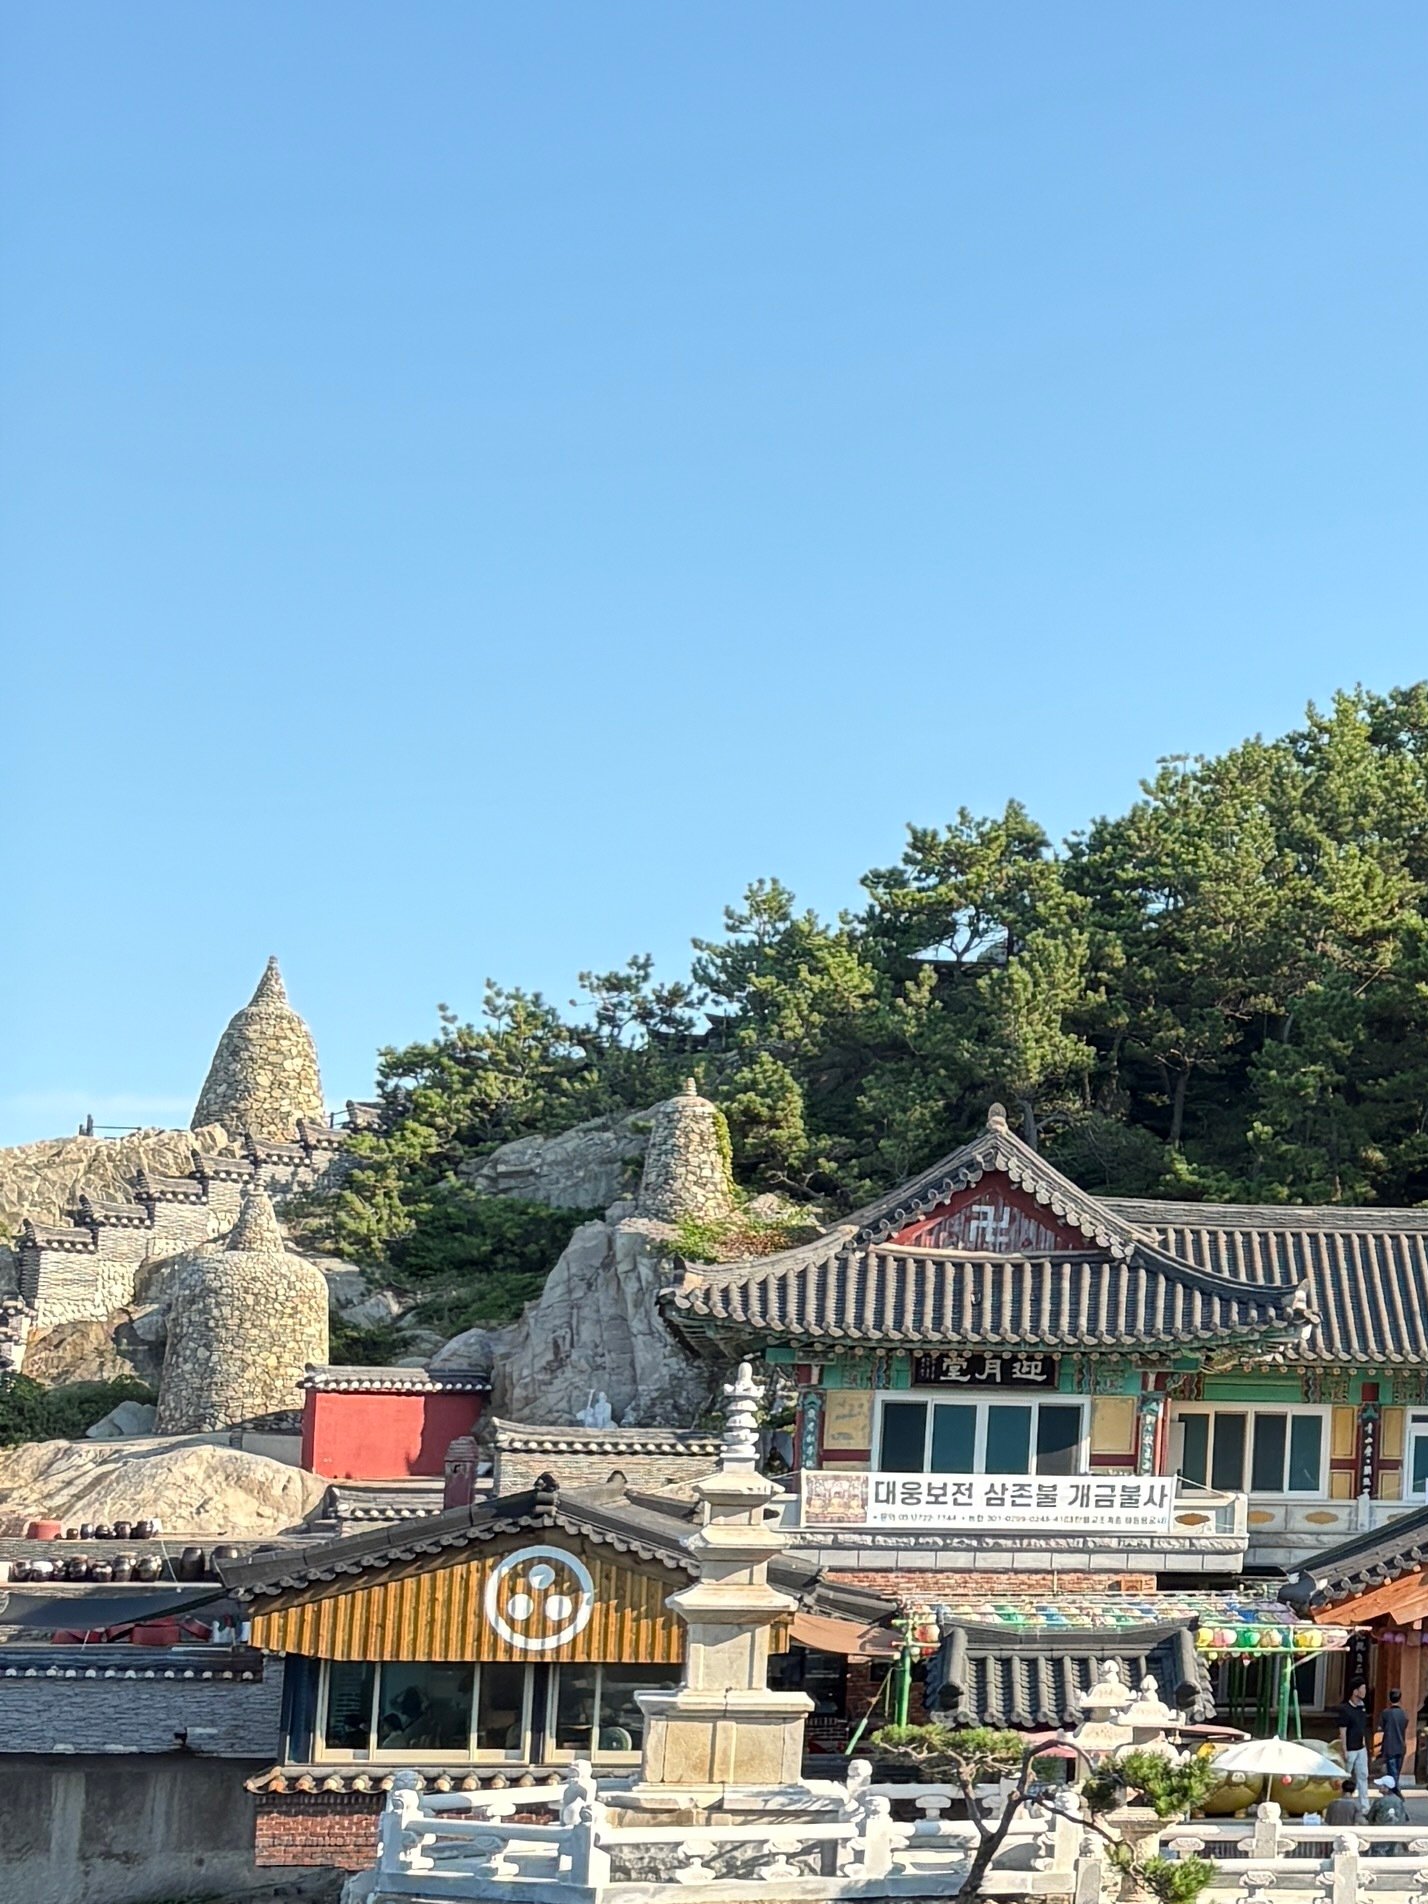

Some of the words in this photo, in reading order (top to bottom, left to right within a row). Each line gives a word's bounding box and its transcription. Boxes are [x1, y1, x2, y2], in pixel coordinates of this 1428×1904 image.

[874, 1480, 974, 1507] 대웅보전
[984, 1482, 1059, 1508] 삼존불
[1067, 1484, 1169, 1509] 개금불사
